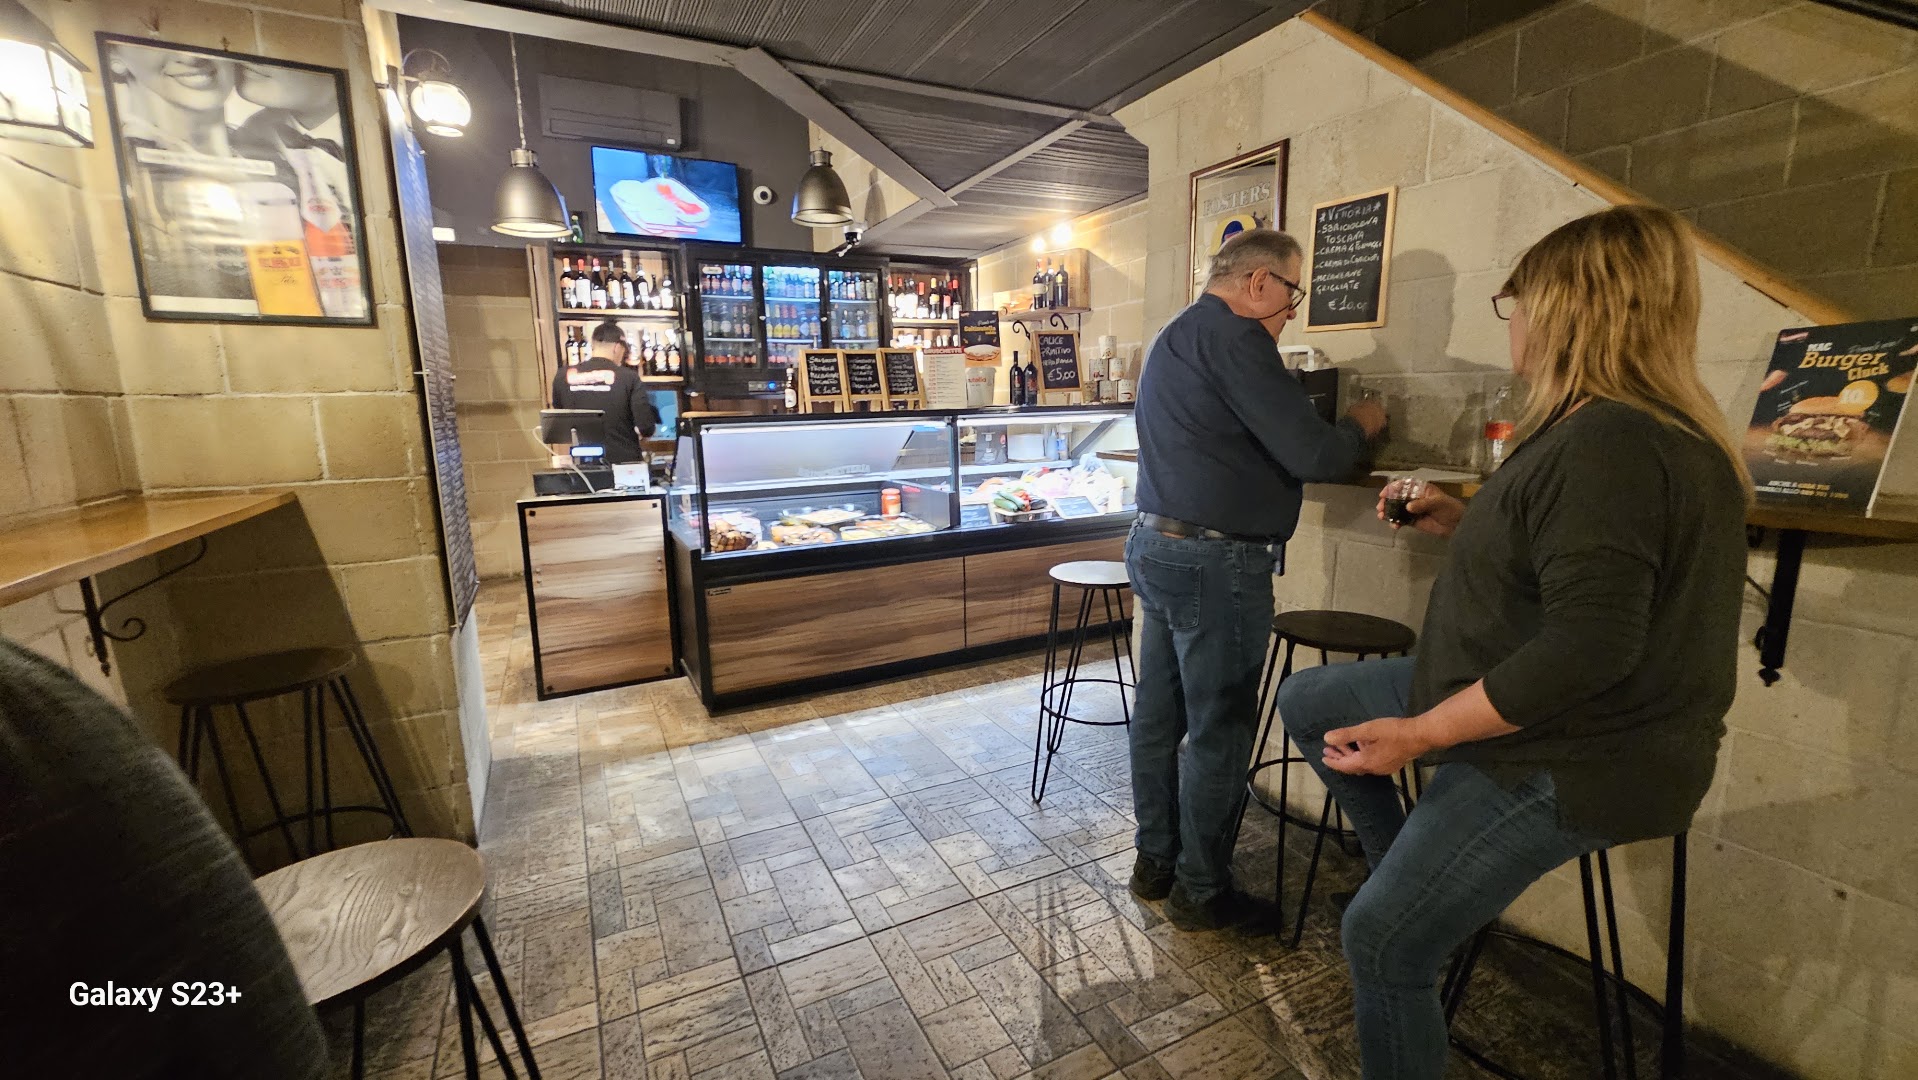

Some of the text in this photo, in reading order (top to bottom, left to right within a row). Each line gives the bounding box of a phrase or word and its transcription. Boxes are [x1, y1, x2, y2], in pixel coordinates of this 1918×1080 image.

[1324, 231, 1364, 244] TOSCANA
[1039, 336, 1064, 345] CALICE
[1798, 352, 1887, 370] Burger
